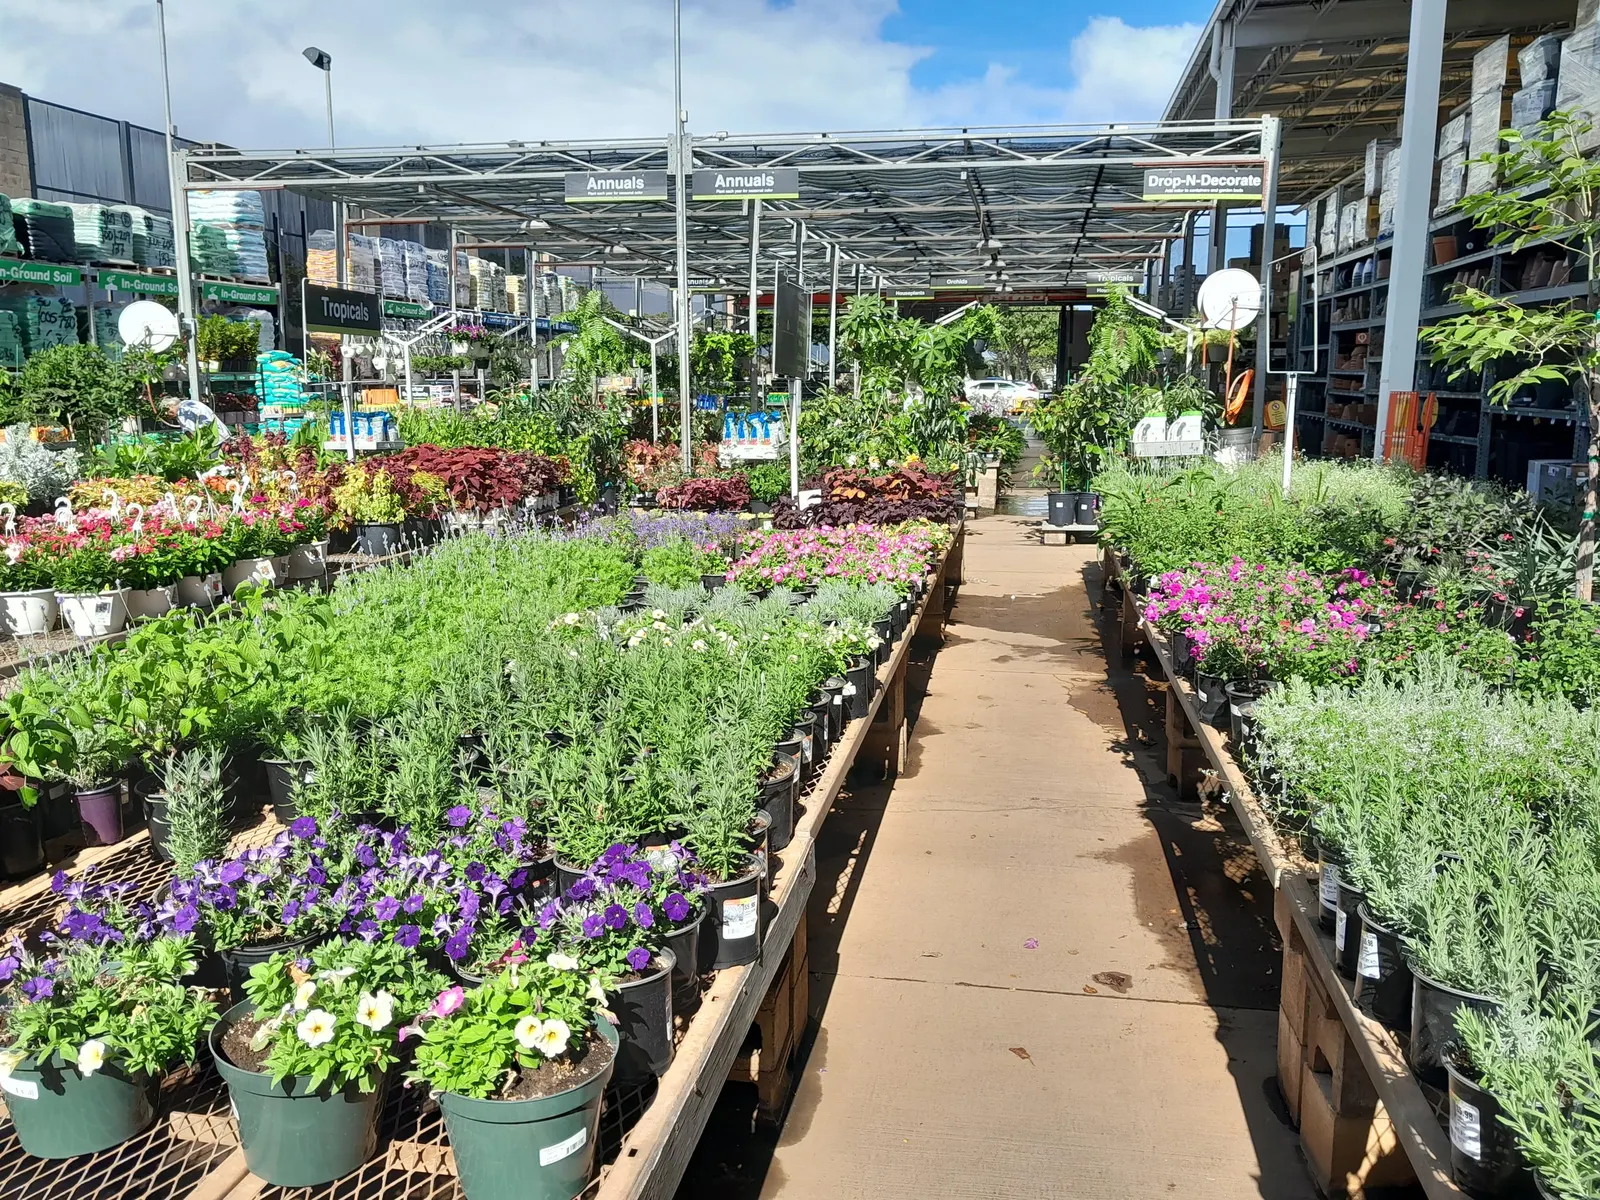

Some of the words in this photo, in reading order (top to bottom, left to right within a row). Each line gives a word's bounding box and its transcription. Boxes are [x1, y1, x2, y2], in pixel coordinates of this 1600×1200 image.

[586, 175, 645, 190] Annuals
[714, 172, 775, 188] Annuals
[1148, 173, 1262, 189] Drop-N-Decorate
[0, 266, 50, 281] n-Ground
[53, 270, 72, 283] Soil
[1096, 274, 1134, 282] Tropicals
[121, 278, 166, 292] In-Ground
[167, 282, 178, 293] So
[221, 288, 256, 301] In-Ground
[257, 292, 270, 302] Soil
[320, 296, 369, 323] Tropicals
[395, 304, 418, 315] In-Ground
